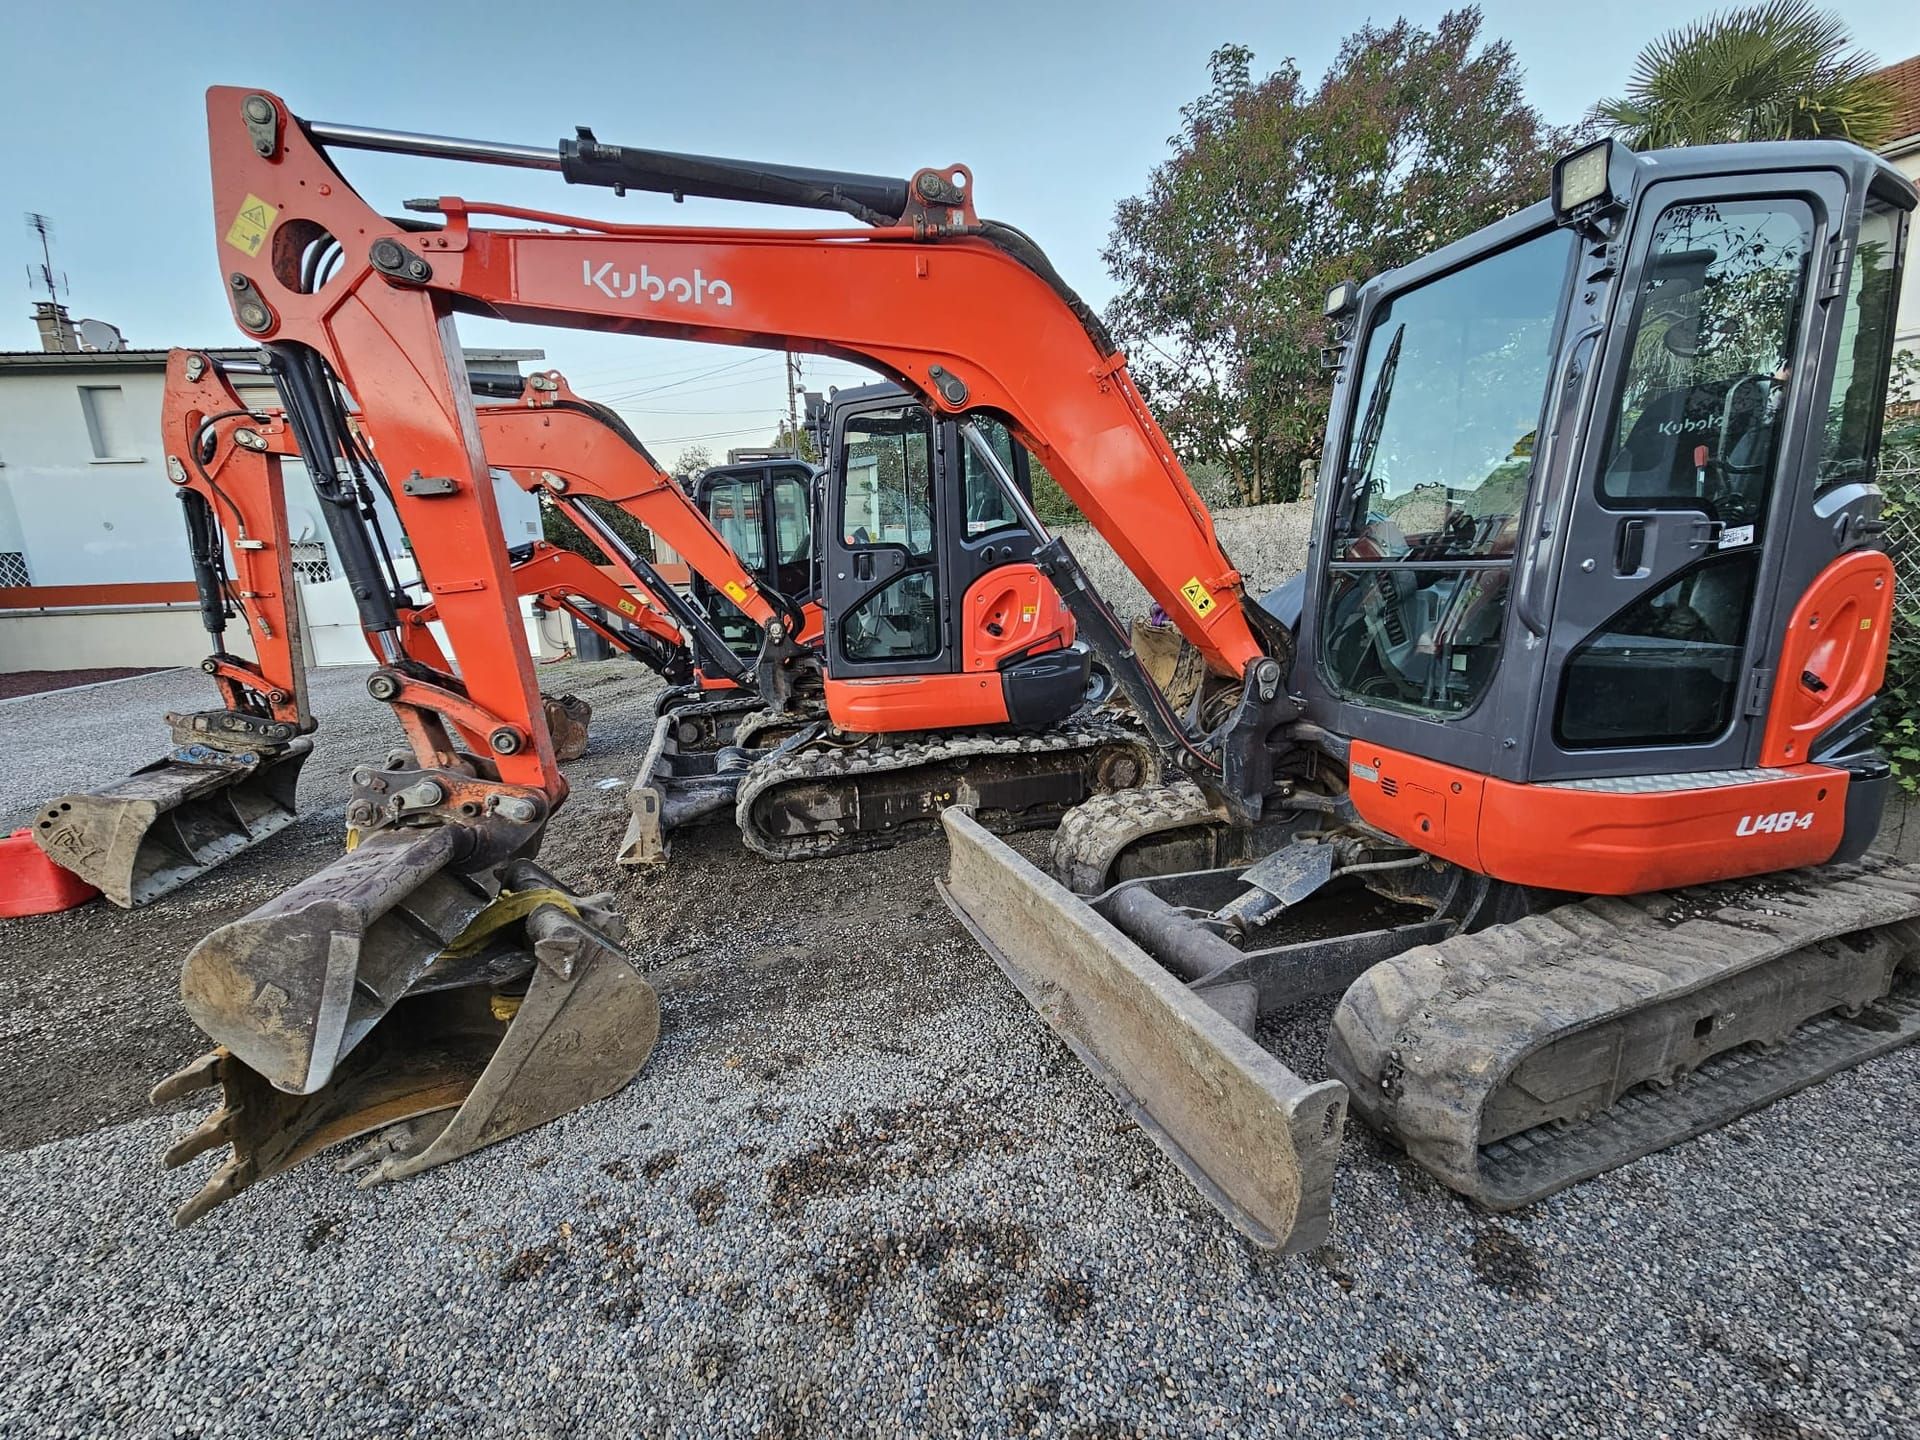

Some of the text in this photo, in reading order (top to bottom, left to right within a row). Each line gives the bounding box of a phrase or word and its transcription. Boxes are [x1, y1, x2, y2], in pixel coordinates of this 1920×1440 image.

[583, 260, 733, 306] Kubota
[1658, 414, 1728, 436] Kubota
[1736, 811, 1815, 837] U48-4
